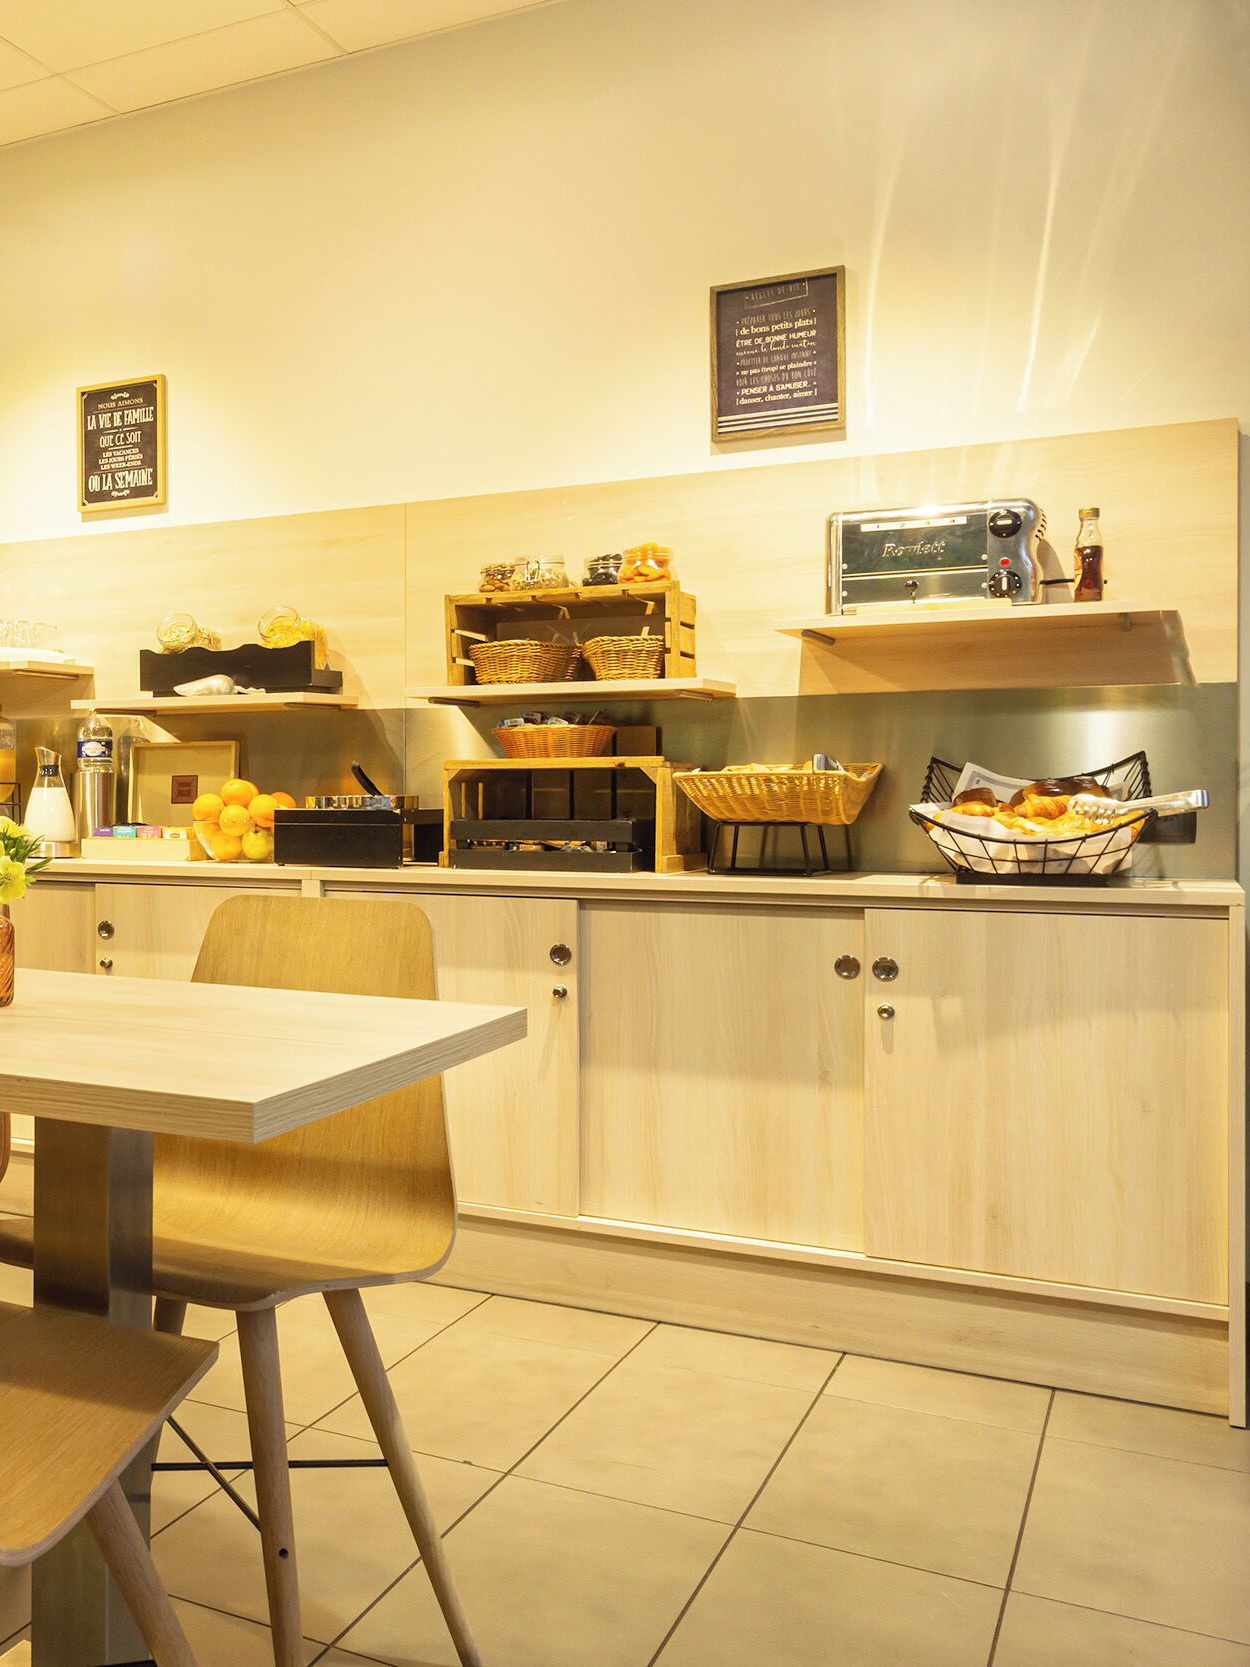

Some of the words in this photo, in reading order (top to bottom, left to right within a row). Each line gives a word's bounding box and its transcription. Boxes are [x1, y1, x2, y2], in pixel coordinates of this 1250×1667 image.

[740, 326, 750, 336] de
[751, 324, 770, 334] bons
[771, 320, 793, 332] petits
[794, 318, 814, 329] plats
[754, 336, 764, 345] DE
[765, 332, 787, 343] BONNE
[789, 329, 817, 340] HUMEUR
[749, 367, 760, 375] pas
[761, 365, 778, 373] (trop)
[787, 360, 813, 370] plaindre
[739, 396, 764, 405] danser,
[764, 392, 792, 402] chanter,
[793, 389, 813, 398] aimer
[741, 385, 768, 395] PENSER
[769, 383, 774, 392] À
[98, 402, 116, 410] NOUS
[118, 398, 143, 407] AIMONS
[87, 415, 97, 431] LA
[98, 412, 111, 429] VIE
[113, 411, 123, 427] DE
[124, 407, 154, 425] FAMILLE
[99, 434, 114, 448] QUE
[115, 433, 125, 446] CE
[125, 431, 142, 444] SOIT
[112, 448, 139, 456] VACANCES
[89, 475, 101, 492] OU
[102, 473, 113, 491] LA
[115, 469, 153, 489] SEMAINE
